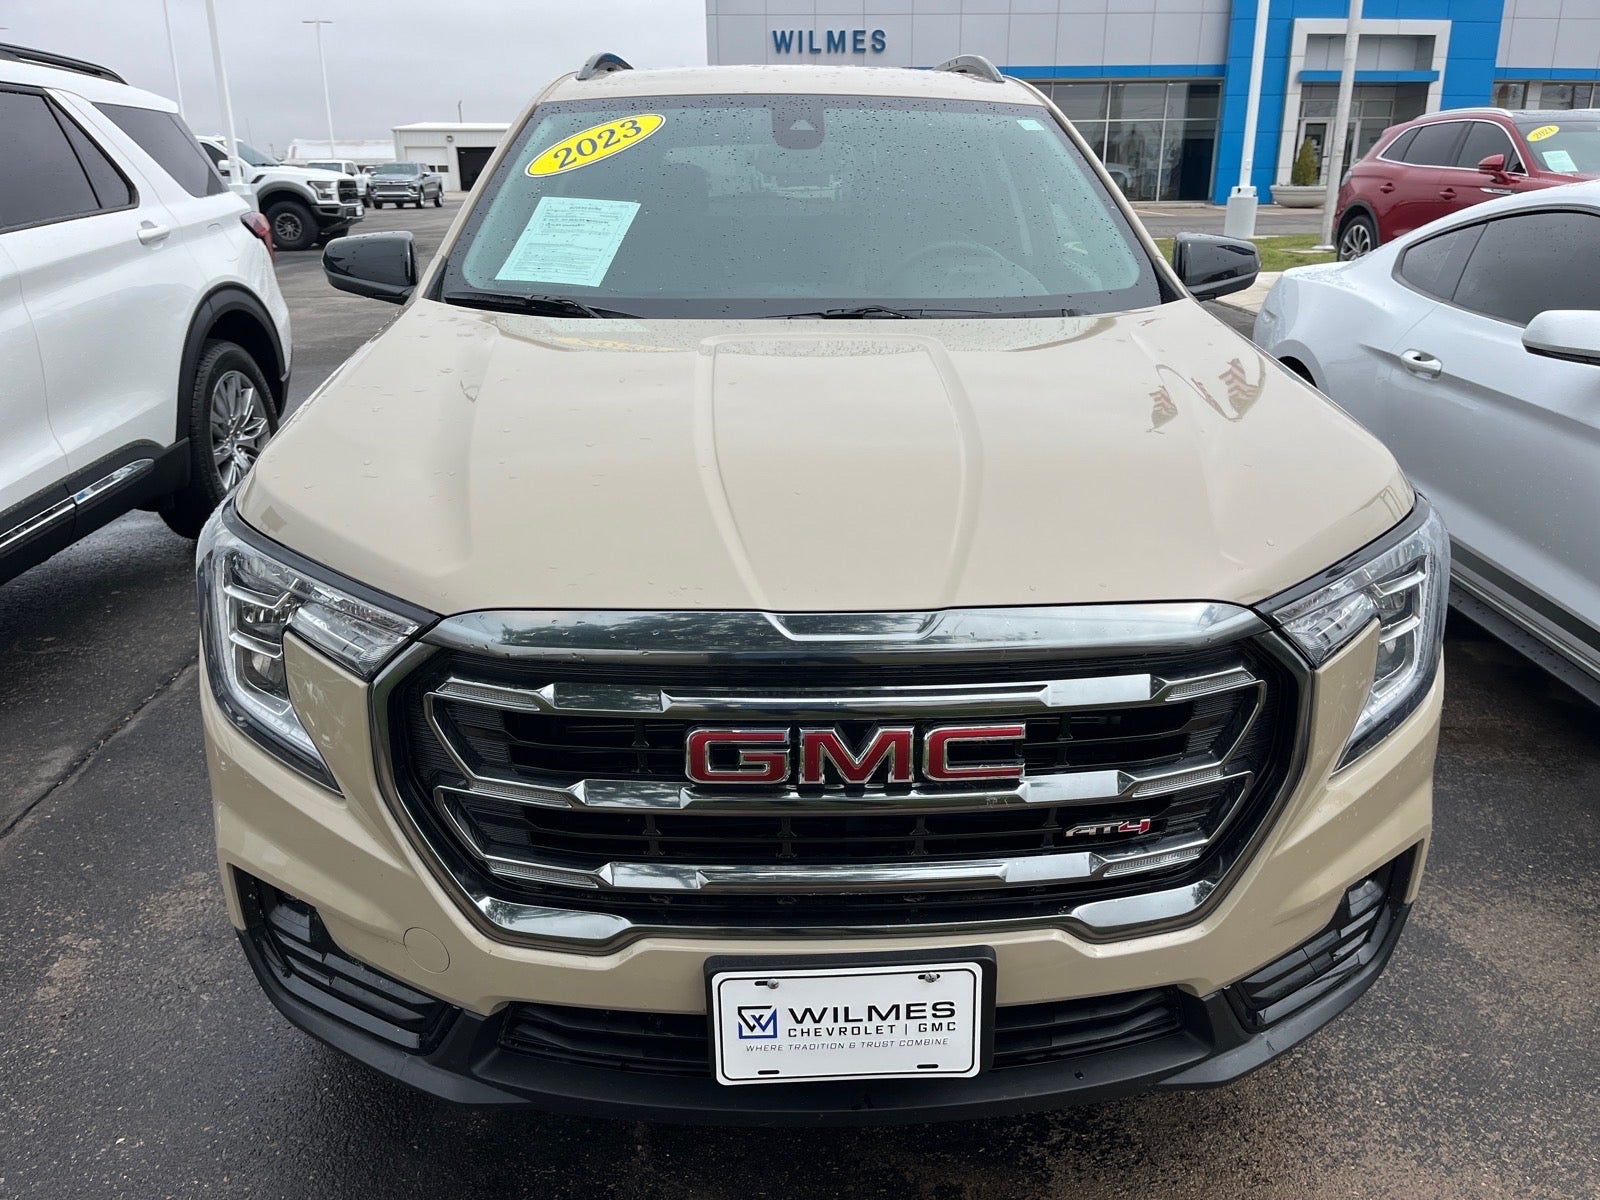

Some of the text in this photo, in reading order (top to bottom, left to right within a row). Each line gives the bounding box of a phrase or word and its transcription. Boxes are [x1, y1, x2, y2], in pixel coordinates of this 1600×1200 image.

[772, 30, 886, 54] WILMES
[553, 119, 642, 169] 2023
[684, 722, 1026, 785] GMC
[1065, 817, 1151, 837] AT4
[788, 1001, 956, 1024] WILMES
[788, 1024, 896, 1037] CHEVROLET
[918, 1021, 957, 1032] GMC
[745, 1044, 784, 1052] WHERE
[788, 1041, 845, 1050] TRADITION
[860, 1040, 895, 1048] TRUST
[899, 1037, 949, 1047] COMBINE
